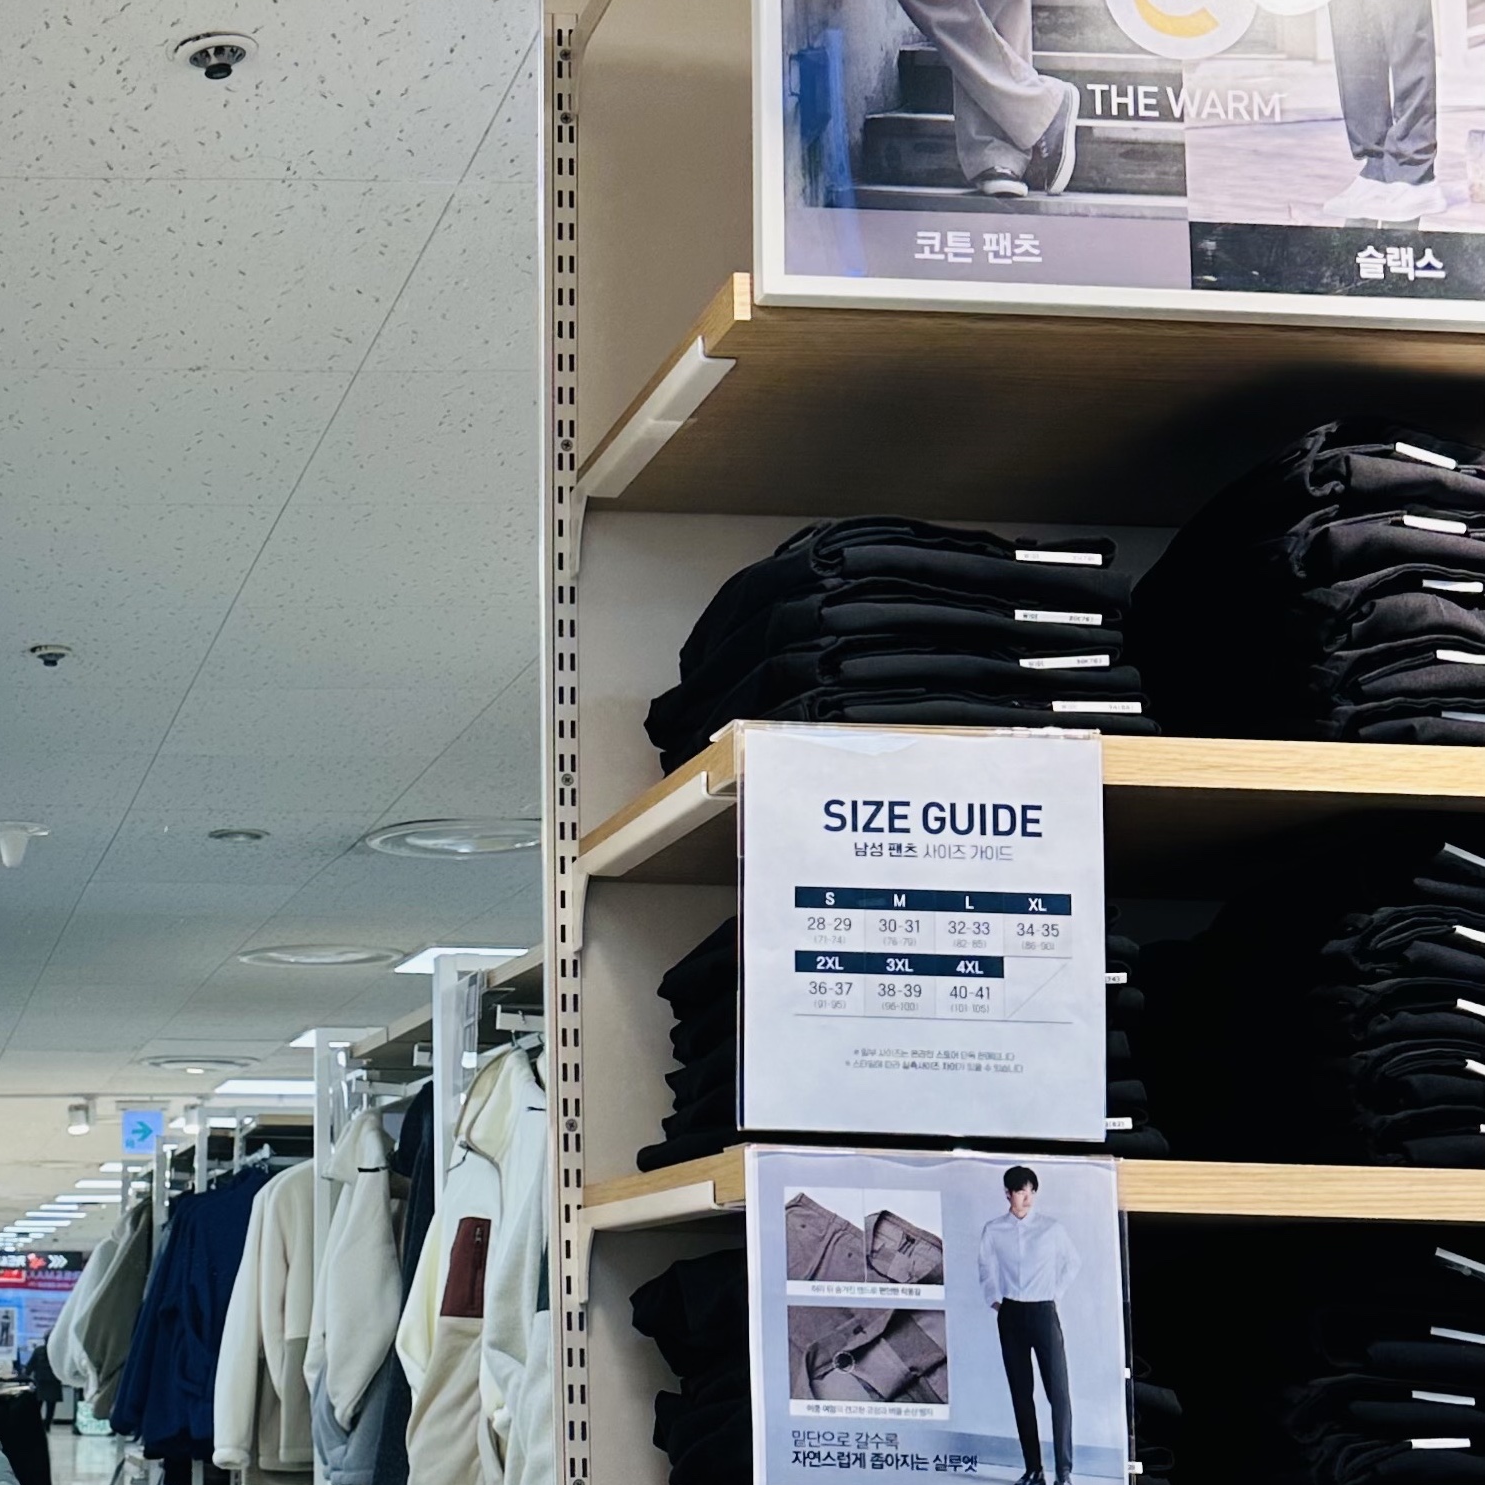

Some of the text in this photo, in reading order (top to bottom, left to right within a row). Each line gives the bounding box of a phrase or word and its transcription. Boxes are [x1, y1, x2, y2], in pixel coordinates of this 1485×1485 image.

[1087, 83, 1282, 122] THE WARM
[914, 231, 1043, 264] 코튼 팬츠
[1356, 244, 1446, 281] 슬랙스
[823, 798, 1043, 837] SIZE GUIDE
[854, 842, 1014, 861] 남성 팬츠 사이즈 가이드
[825, 892, 1047, 912] S M L XL
[807, 917, 1059, 937] 28-29 30-31 32-33 34-35
[816, 957, 983, 975] 2XL 3XL 4XL
[809, 981, 991, 1000] 36-37 38-39 40-41
[792, 1430, 899, 1450] 밑단으로 갈수록
[792, 1451, 978, 1472] 자연스럽게 좁아지는 실루엣
